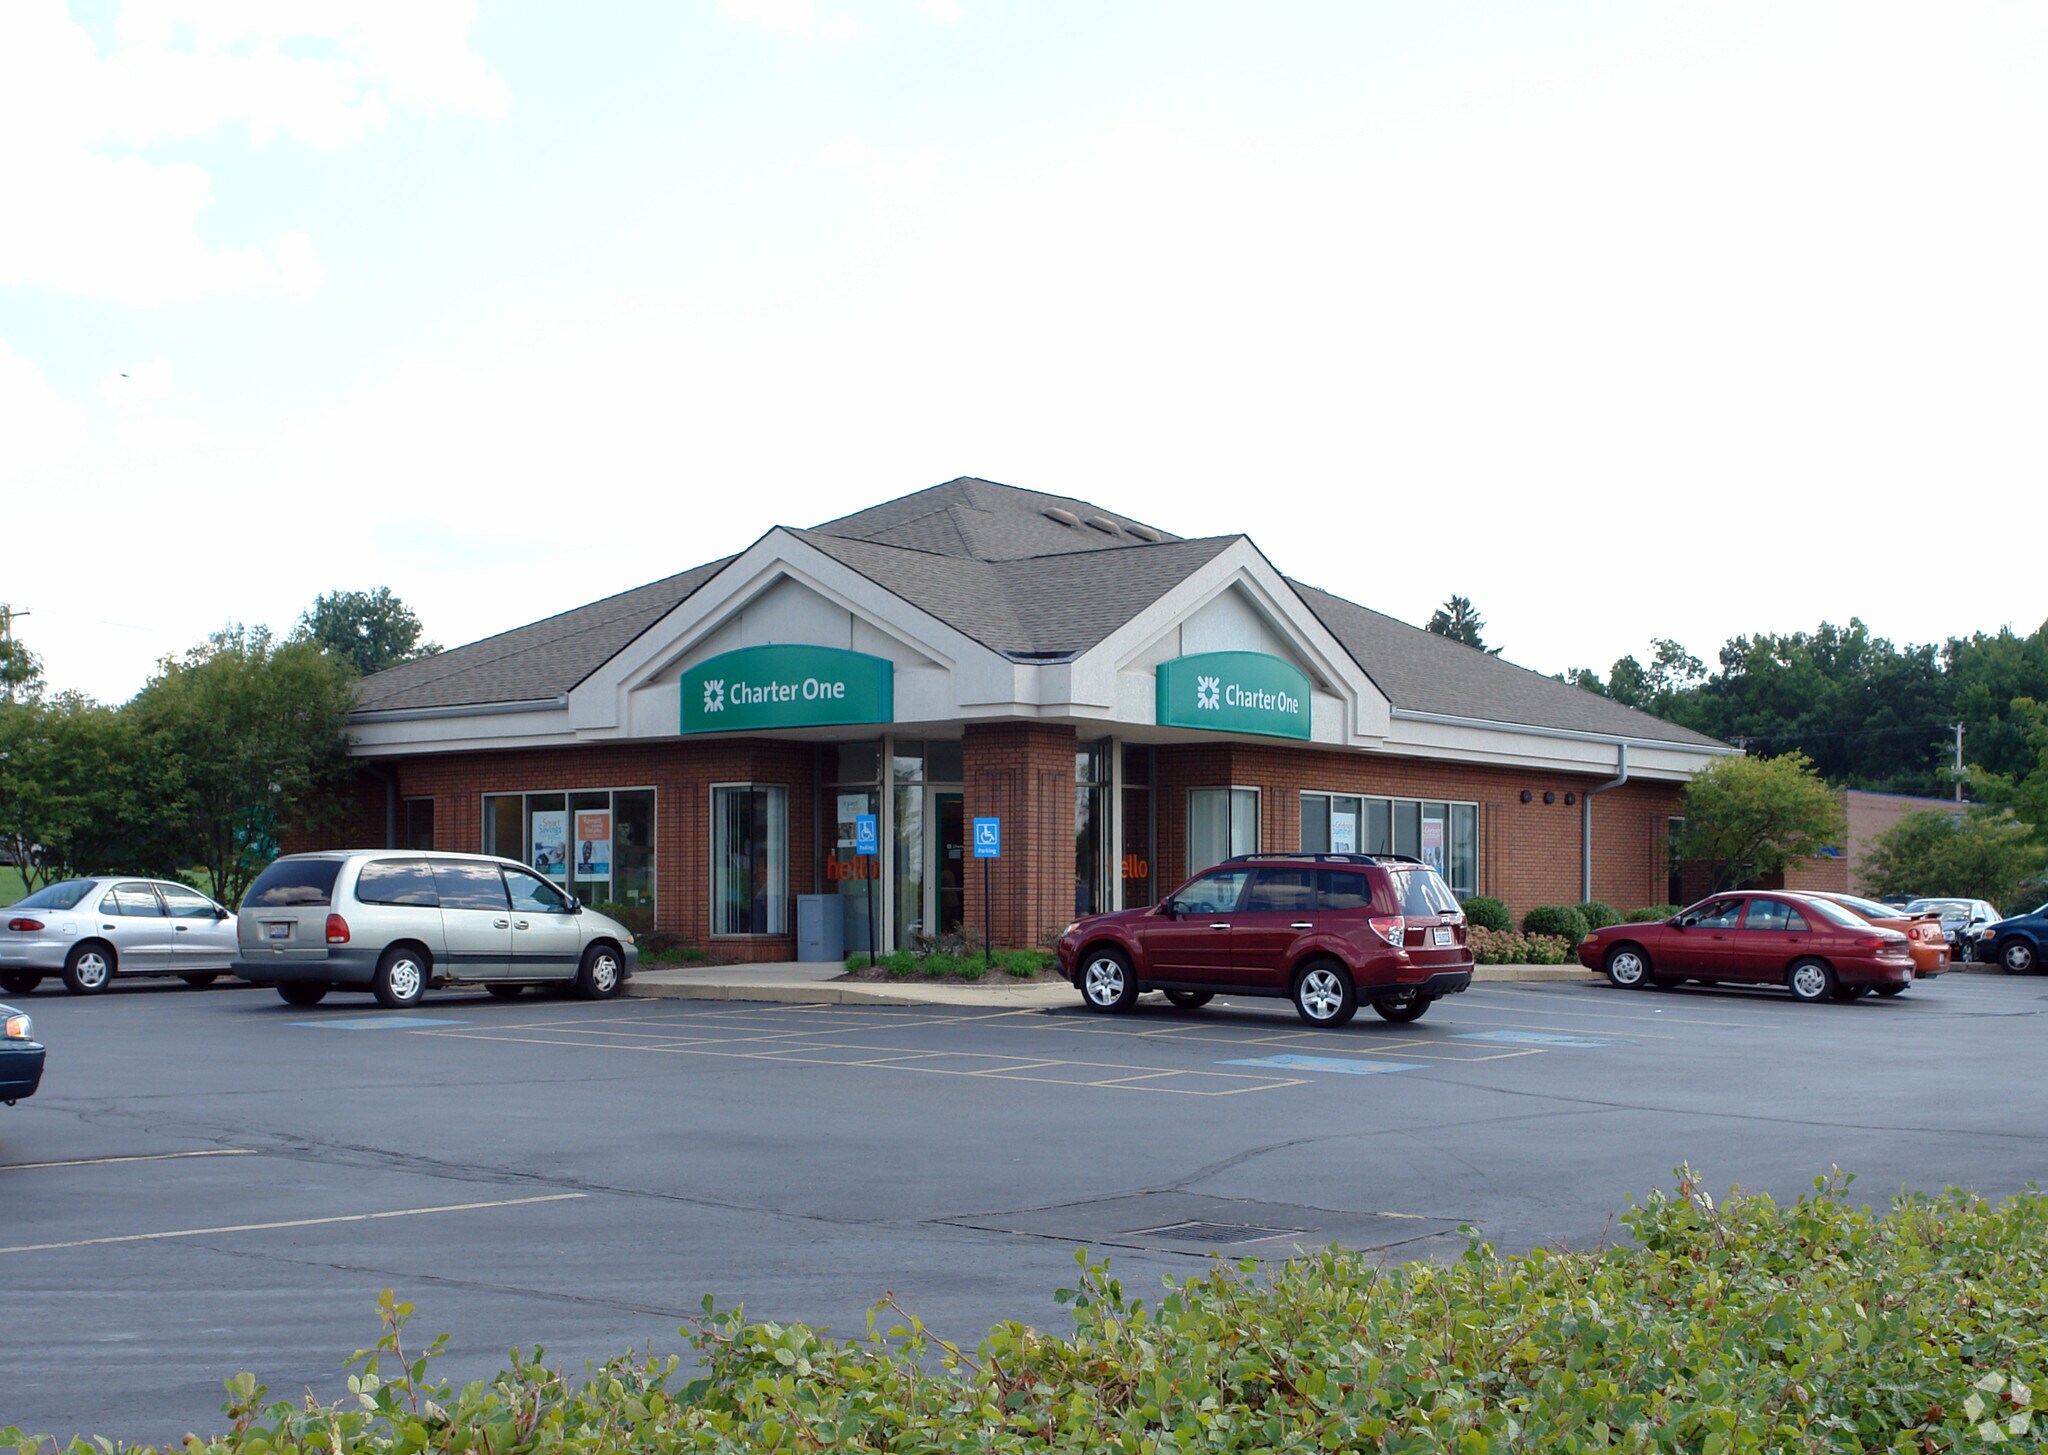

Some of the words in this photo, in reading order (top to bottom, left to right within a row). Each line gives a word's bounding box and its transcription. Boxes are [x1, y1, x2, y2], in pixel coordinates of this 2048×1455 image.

[730, 681, 798, 704] Charter
[802, 678, 845, 701] One
[1225, 684, 1276, 710] Charter
[1277, 691, 1299, 714] One
[538, 824, 562, 835] Savings
[543, 818, 560, 827] Smart
[827, 855, 880, 880] hello
[1119, 853, 1149, 879] ello
